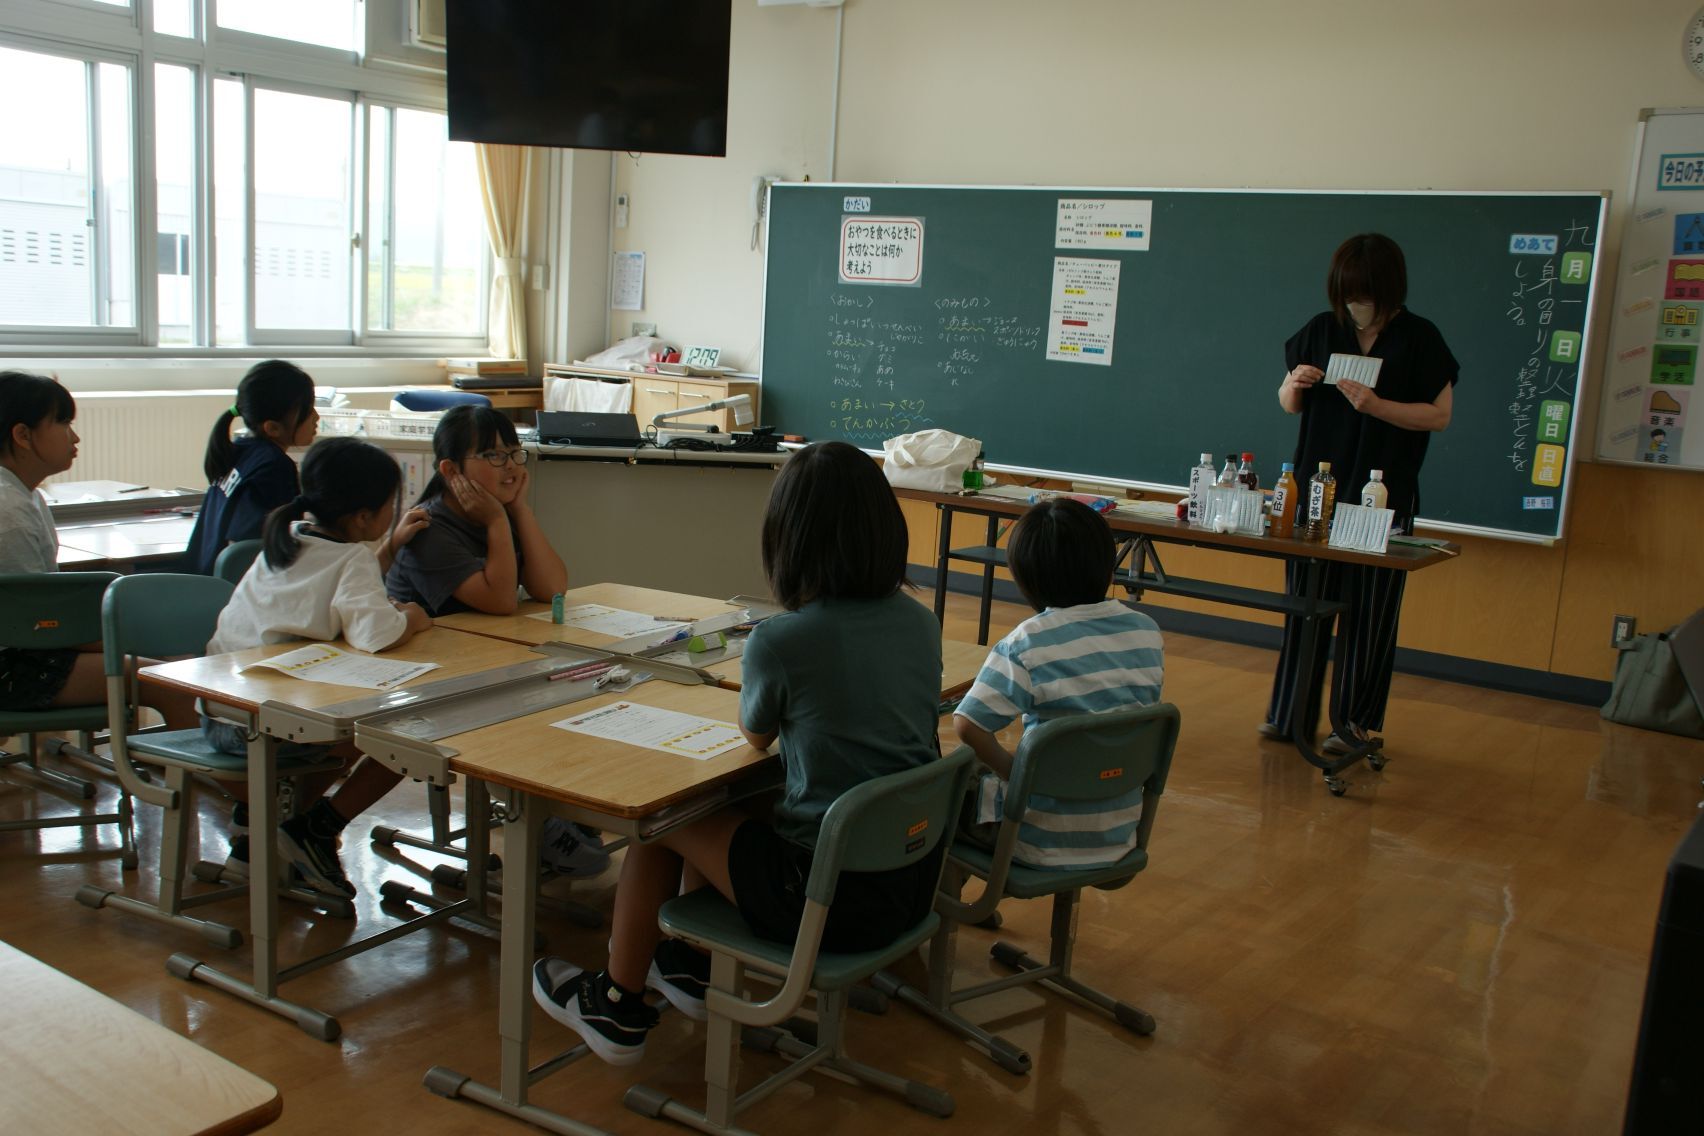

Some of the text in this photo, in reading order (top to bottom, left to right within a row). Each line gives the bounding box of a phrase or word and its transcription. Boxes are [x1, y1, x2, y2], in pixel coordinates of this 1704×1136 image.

[1664, 160, 1704, 183] 今日の予
[845, 199, 869, 210] かだい
[847, 224, 917, 240] おやつを食べるときに
[847, 243, 904, 259] 大切なことは何か
[1513, 237, 1555, 251] めあて
[846, 259, 872, 275] 考えよう
[1567, 259, 1584, 279] 月
[1556, 339, 1573, 357] 日
[1539, 366, 1577, 397] 火
[841, 399, 925, 414] あまい さとう
[1545, 404, 1564, 438] 曜日
[1538, 449, 1557, 482] 日直
[1189, 469, 1200, 518] スポーツ飲料
[1272, 491, 1284, 512] 3位
[1310, 484, 1322, 517] むぎ茶
